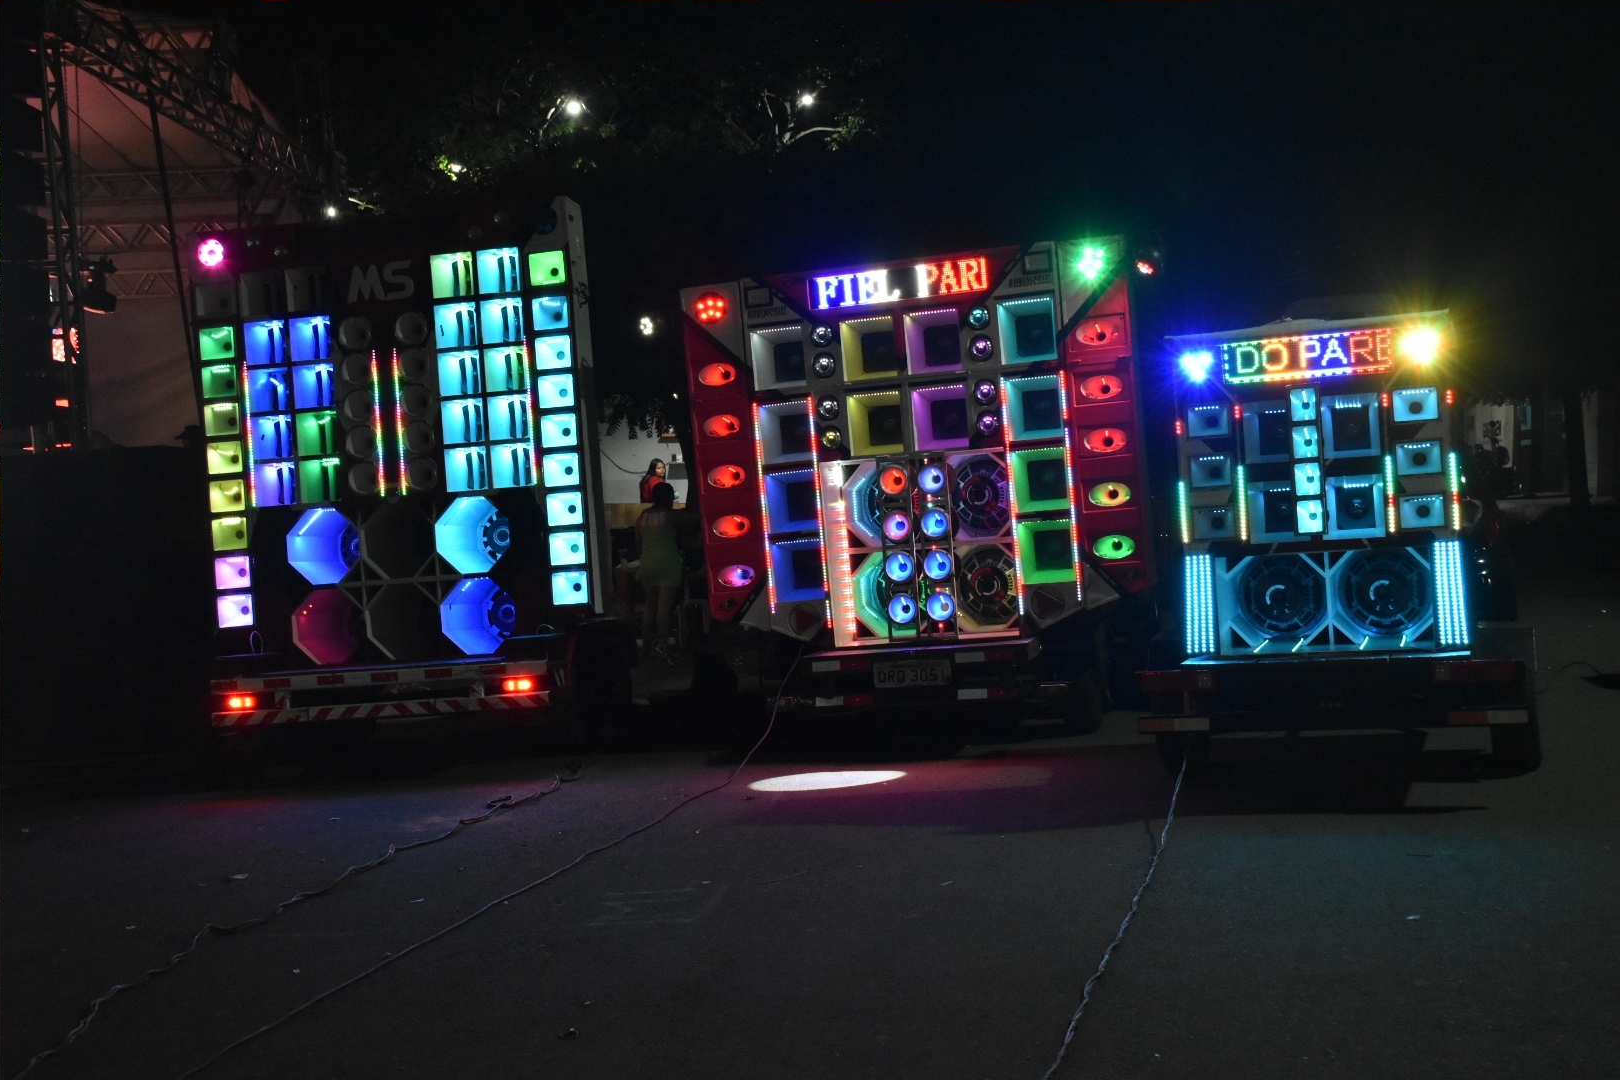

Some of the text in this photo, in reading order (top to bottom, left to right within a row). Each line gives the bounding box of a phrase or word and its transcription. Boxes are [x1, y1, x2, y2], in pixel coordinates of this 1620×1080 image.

[347, 260, 415, 305] MS
[815, 270, 900, 310] FIEL
[1236, 343, 1289, 374] DO
